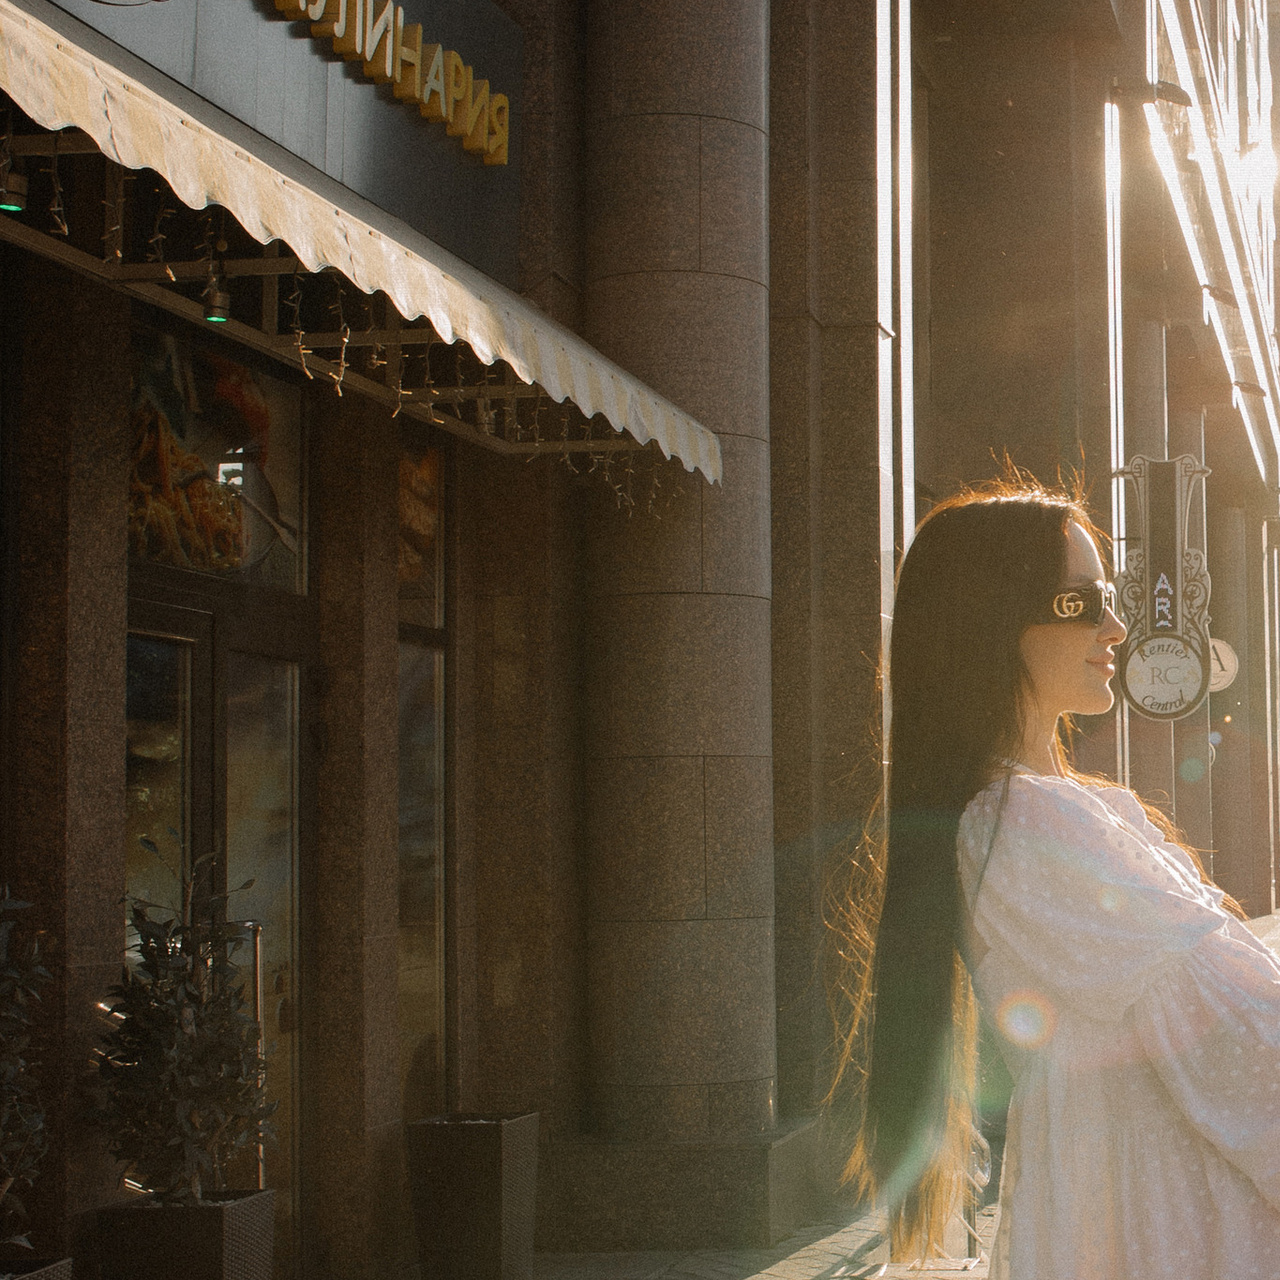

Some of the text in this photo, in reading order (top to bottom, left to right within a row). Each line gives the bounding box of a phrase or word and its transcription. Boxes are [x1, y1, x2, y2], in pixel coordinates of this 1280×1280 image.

[1140, 642, 1190, 662] Rentier
[1150, 666, 1180, 685] RC
[1141, 689, 1186, 711] Central
